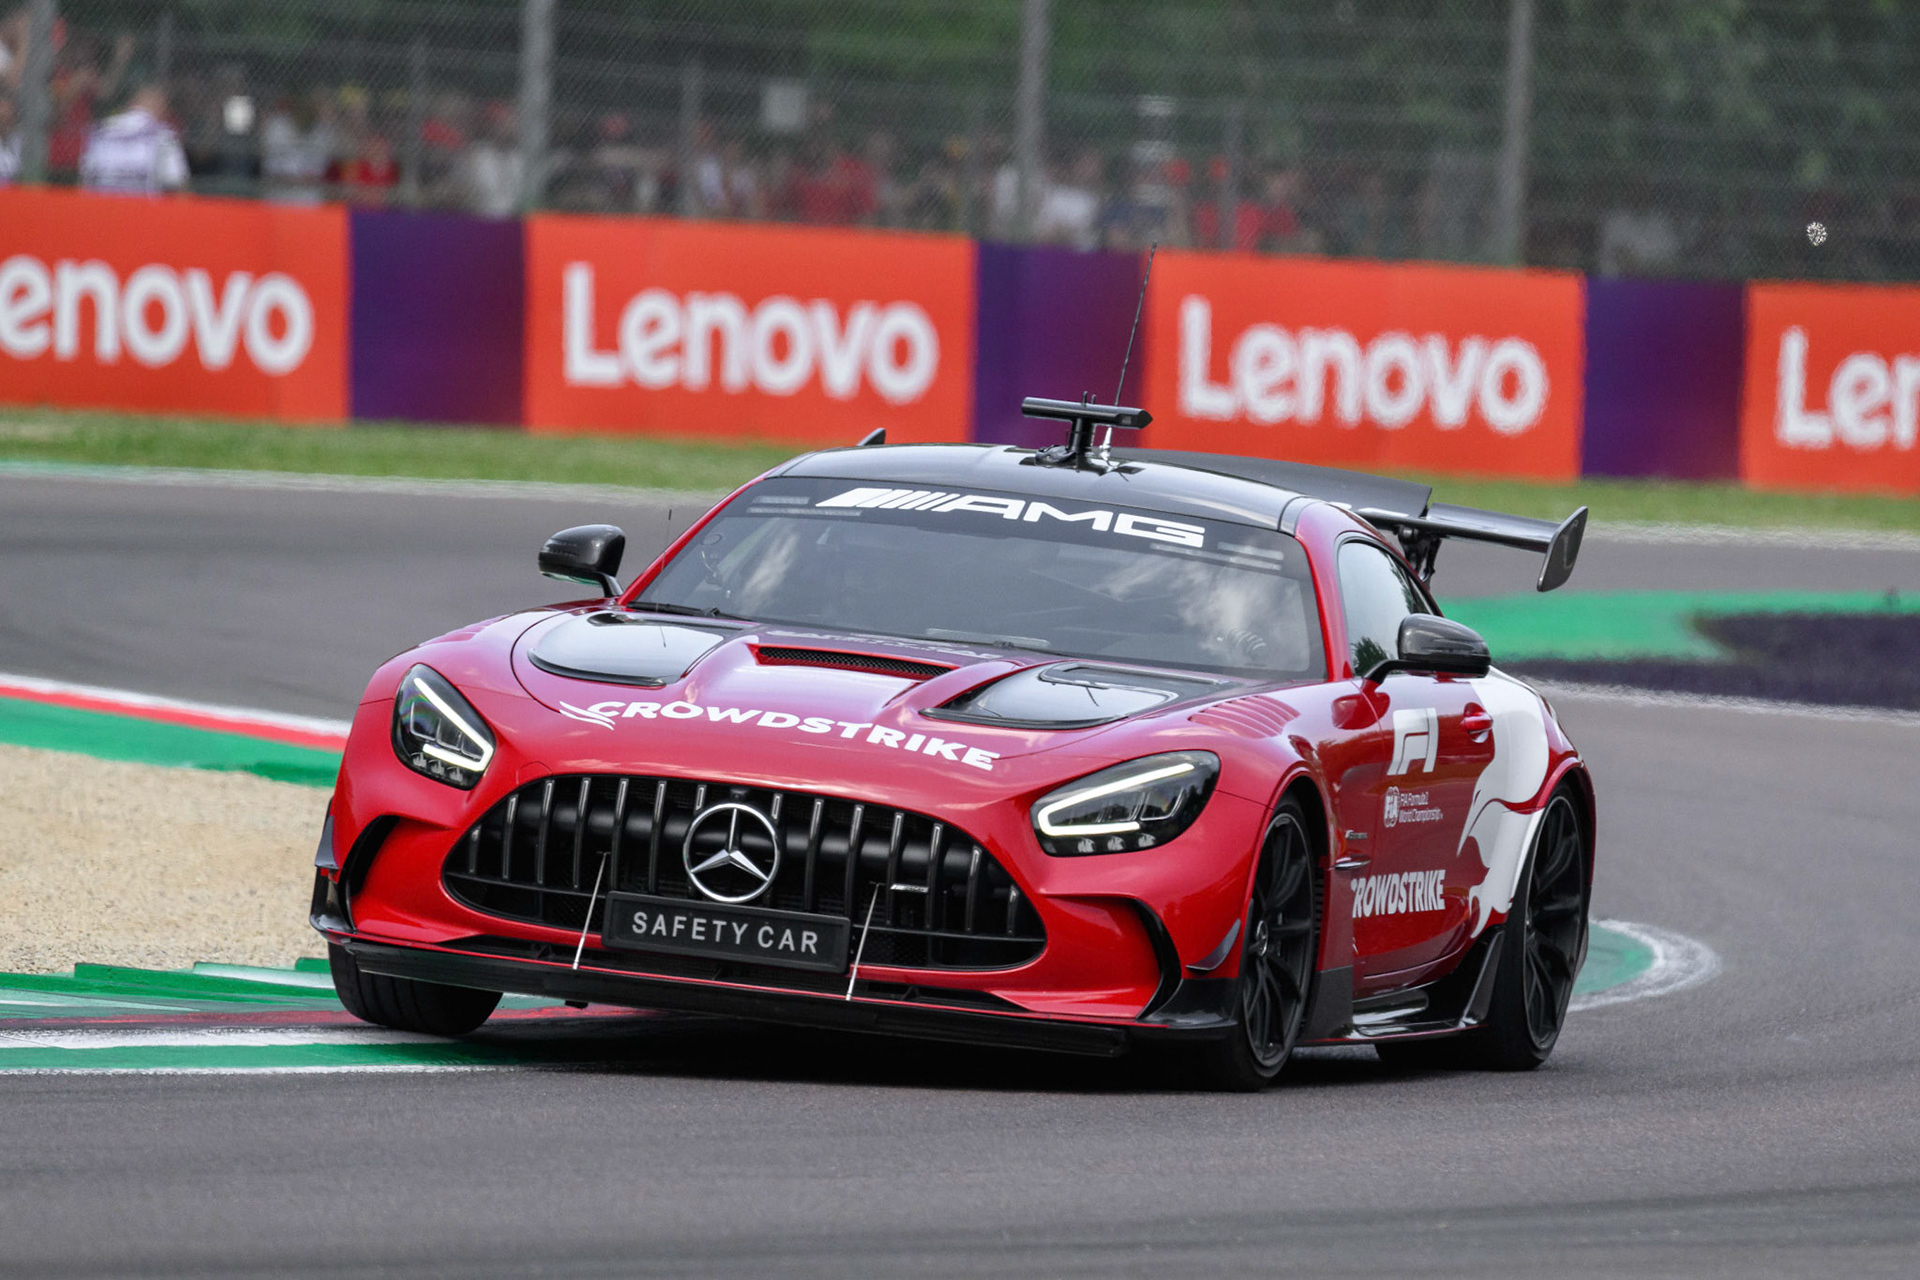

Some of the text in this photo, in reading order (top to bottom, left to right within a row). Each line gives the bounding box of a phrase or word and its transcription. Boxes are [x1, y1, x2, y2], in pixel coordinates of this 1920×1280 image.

[563, 261, 939, 404] Lenovo
[1178, 295, 1550, 436] Lenovo
[930, 494, 1205, 548] AMG
[585, 700, 1000, 771] CROWDSTRIKE
[632, 911, 818, 954] SAFETY CAR
